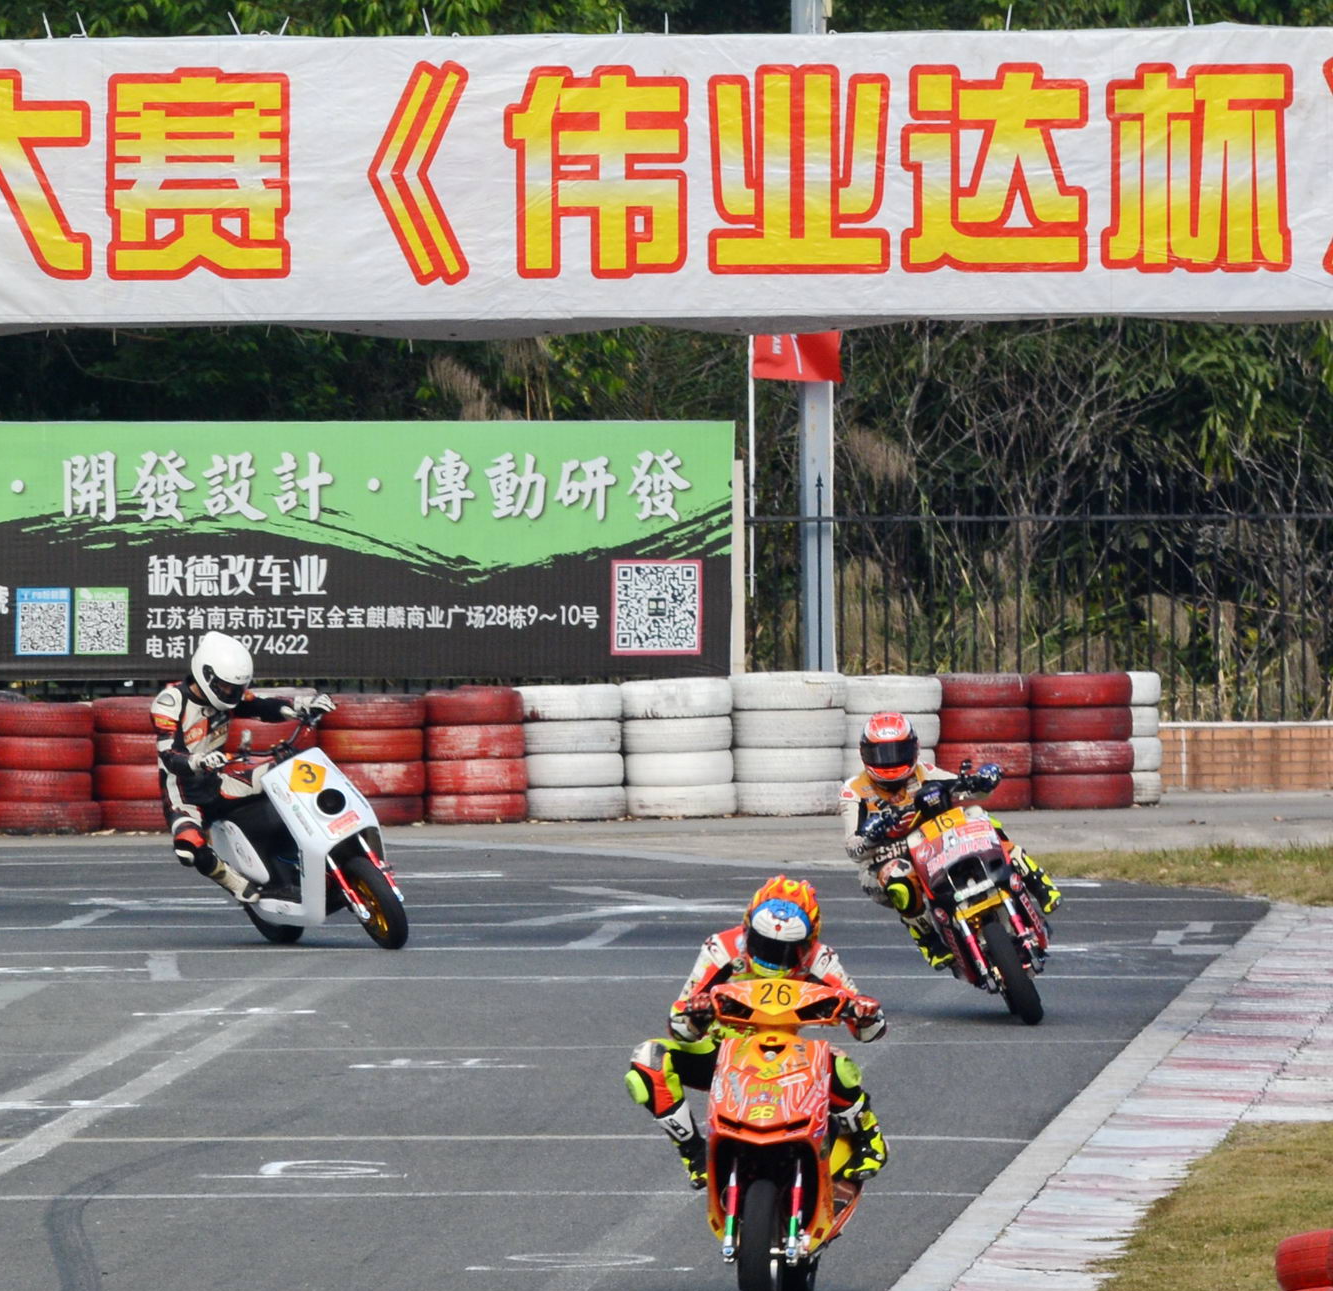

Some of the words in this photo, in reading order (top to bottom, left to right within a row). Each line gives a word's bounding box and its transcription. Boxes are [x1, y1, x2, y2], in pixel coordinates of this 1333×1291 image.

[147, 554, 328, 596] 缺德改车业
[298, 763, 317, 785] 3
[932, 814, 955, 832] 16
[760, 982, 793, 1007] 26
[748, 1105, 776, 1121] 26
